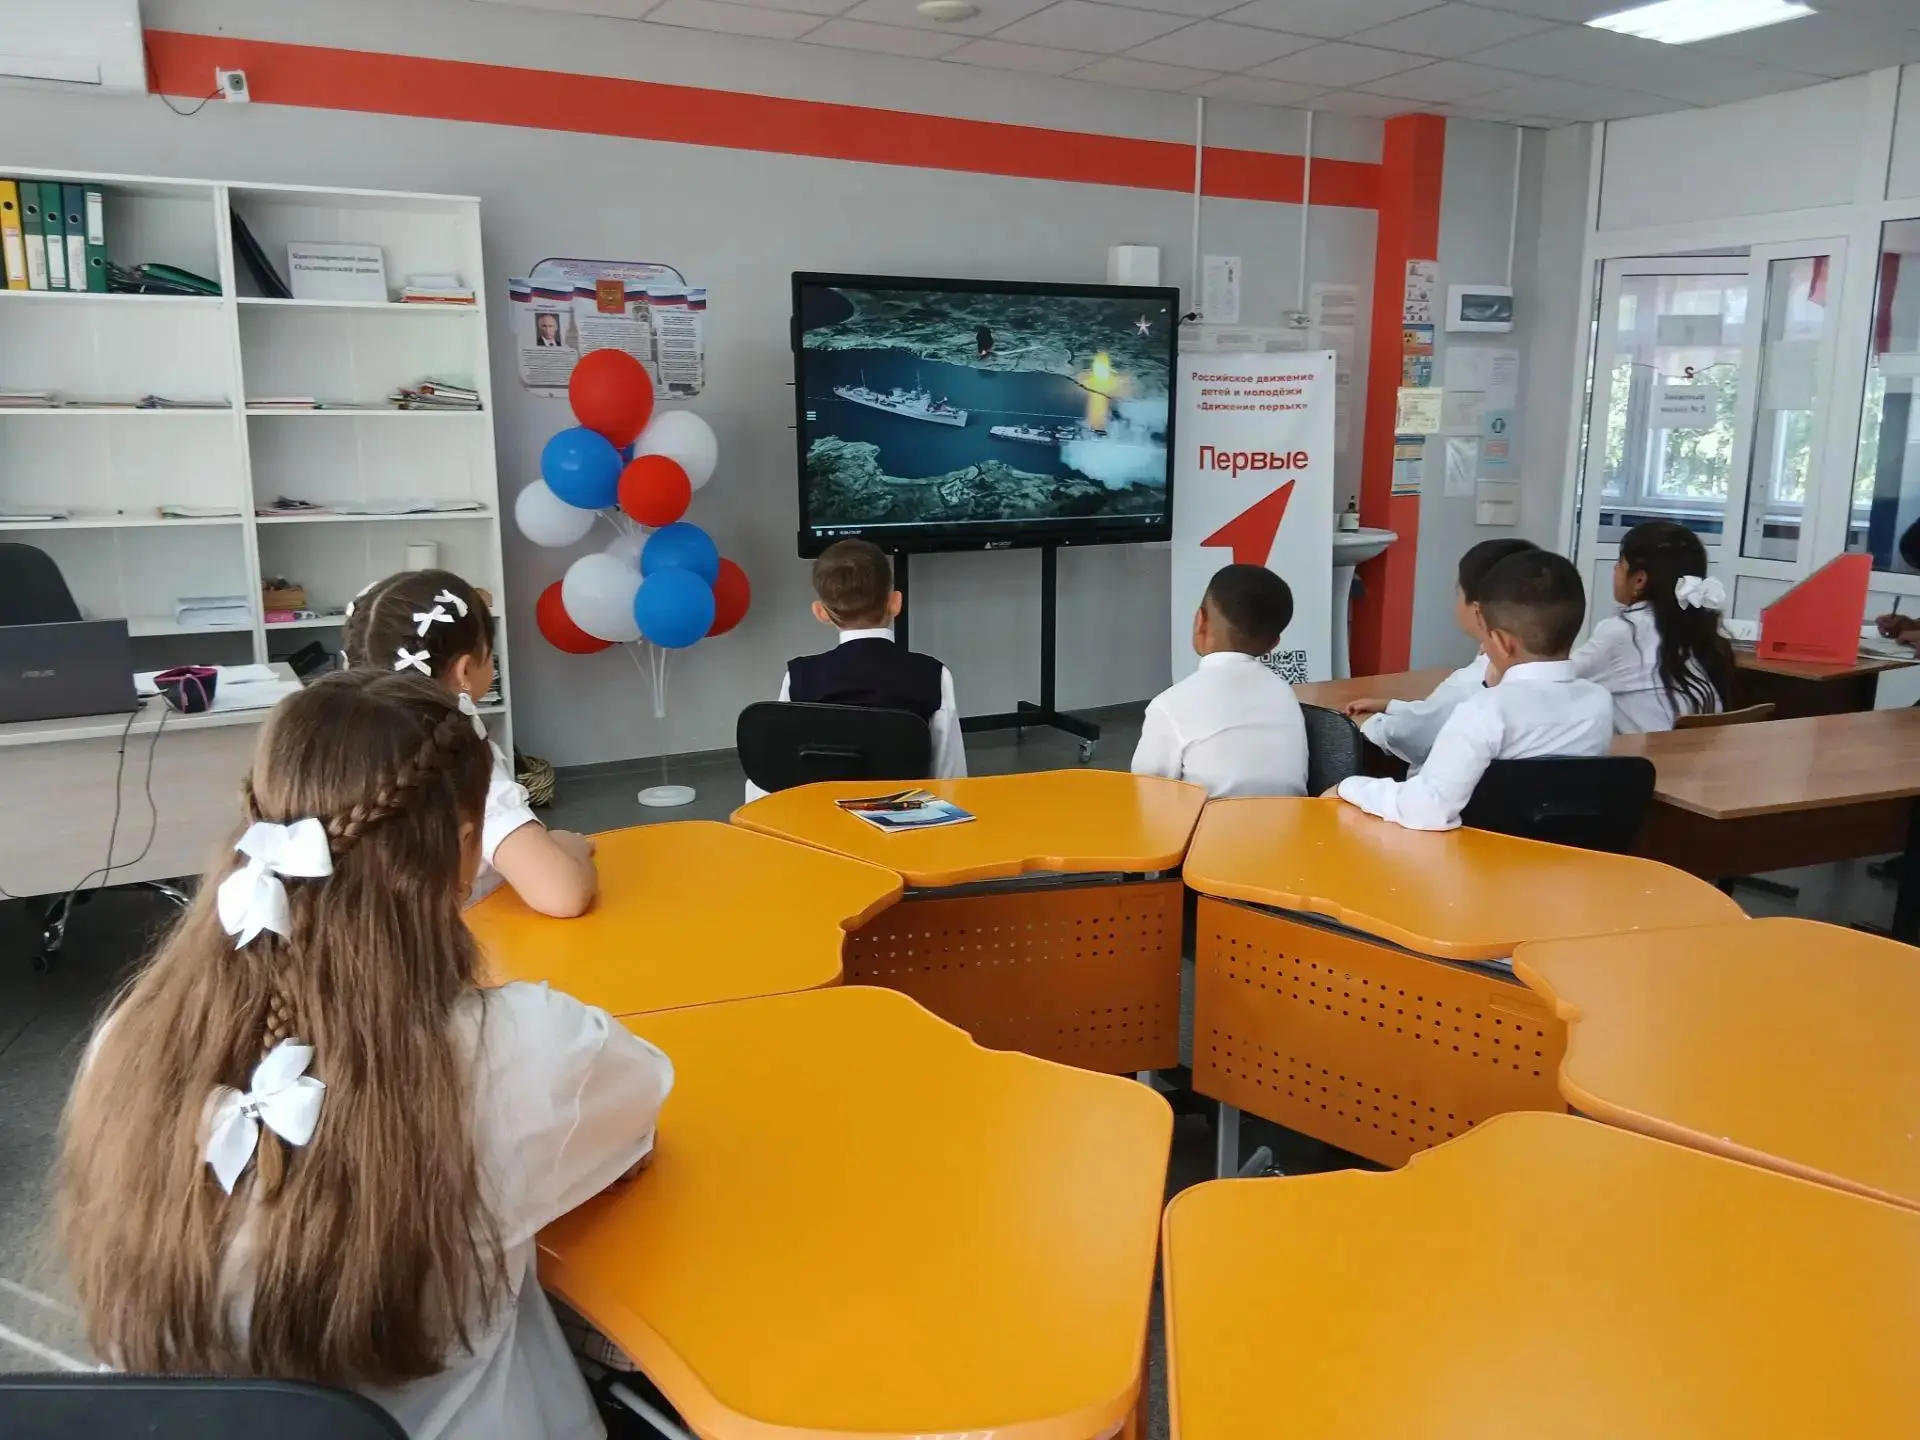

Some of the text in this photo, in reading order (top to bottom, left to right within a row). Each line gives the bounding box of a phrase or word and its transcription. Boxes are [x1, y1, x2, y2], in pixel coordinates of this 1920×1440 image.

[1192, 372, 1315, 384] Российское движение
[1201, 387, 1303, 397] детей и молодёжи
[1197, 401, 1308, 412] «Движение первых»
[1199, 445, 1309, 478] Первые
